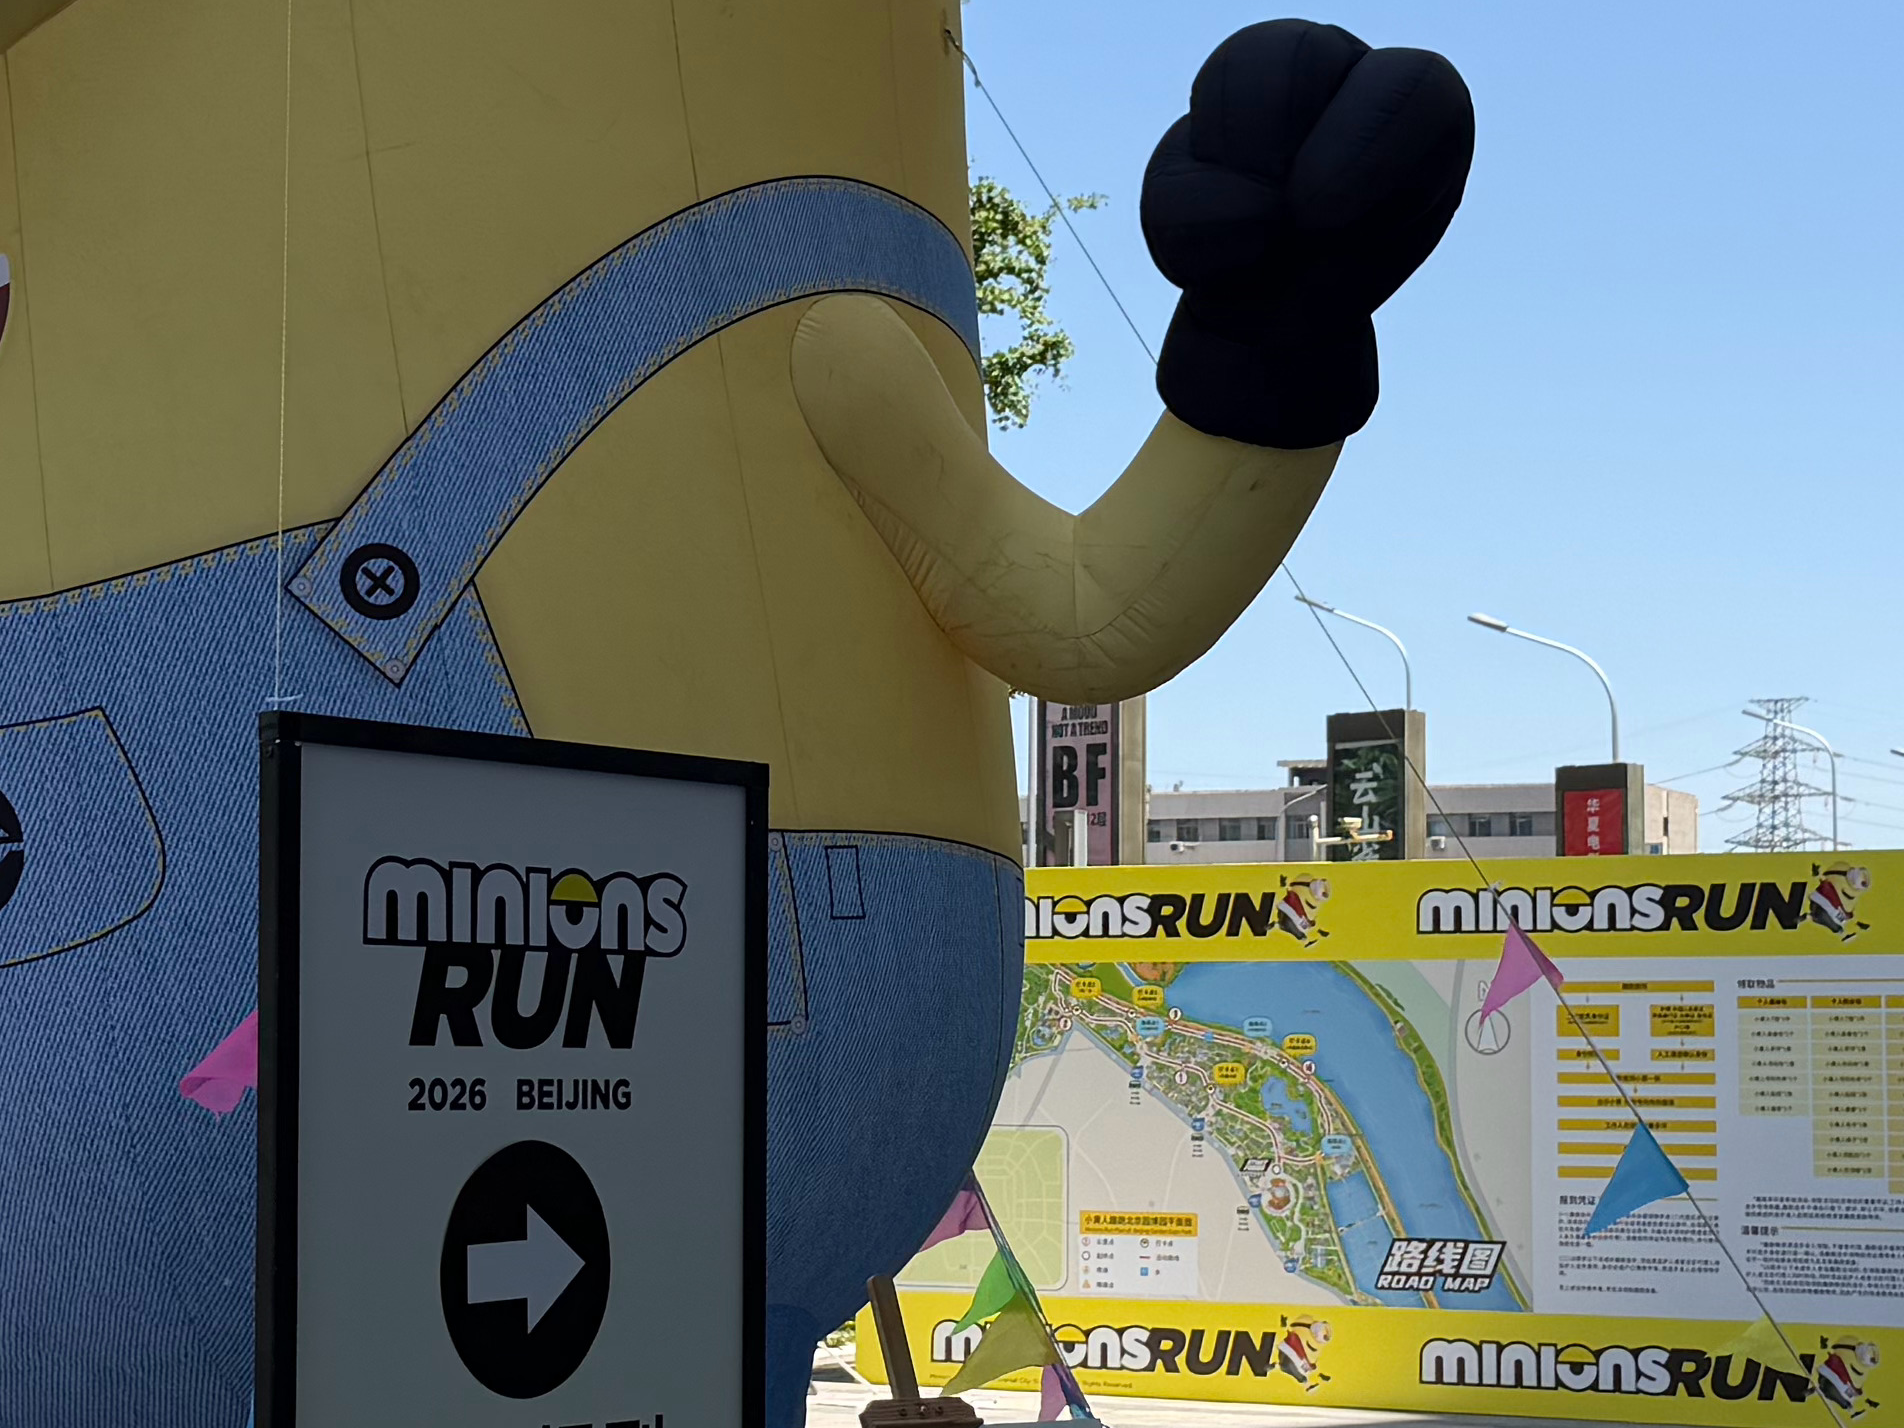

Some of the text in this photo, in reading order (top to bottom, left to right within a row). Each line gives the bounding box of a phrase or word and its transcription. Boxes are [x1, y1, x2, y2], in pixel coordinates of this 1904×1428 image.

[1053, 743, 1107, 808] BF
[1150, 892, 1275, 938] RUN
[1662, 882, 1807, 932] RUN
[409, 946, 647, 1050] RUN
[407, 1078, 632, 1111] 2026 BEIJING
[1382, 1240, 1503, 1276] 路线图
[1377, 1274, 1490, 1292] ROAD MAP
[1147, 1327, 1277, 1378] RUN
